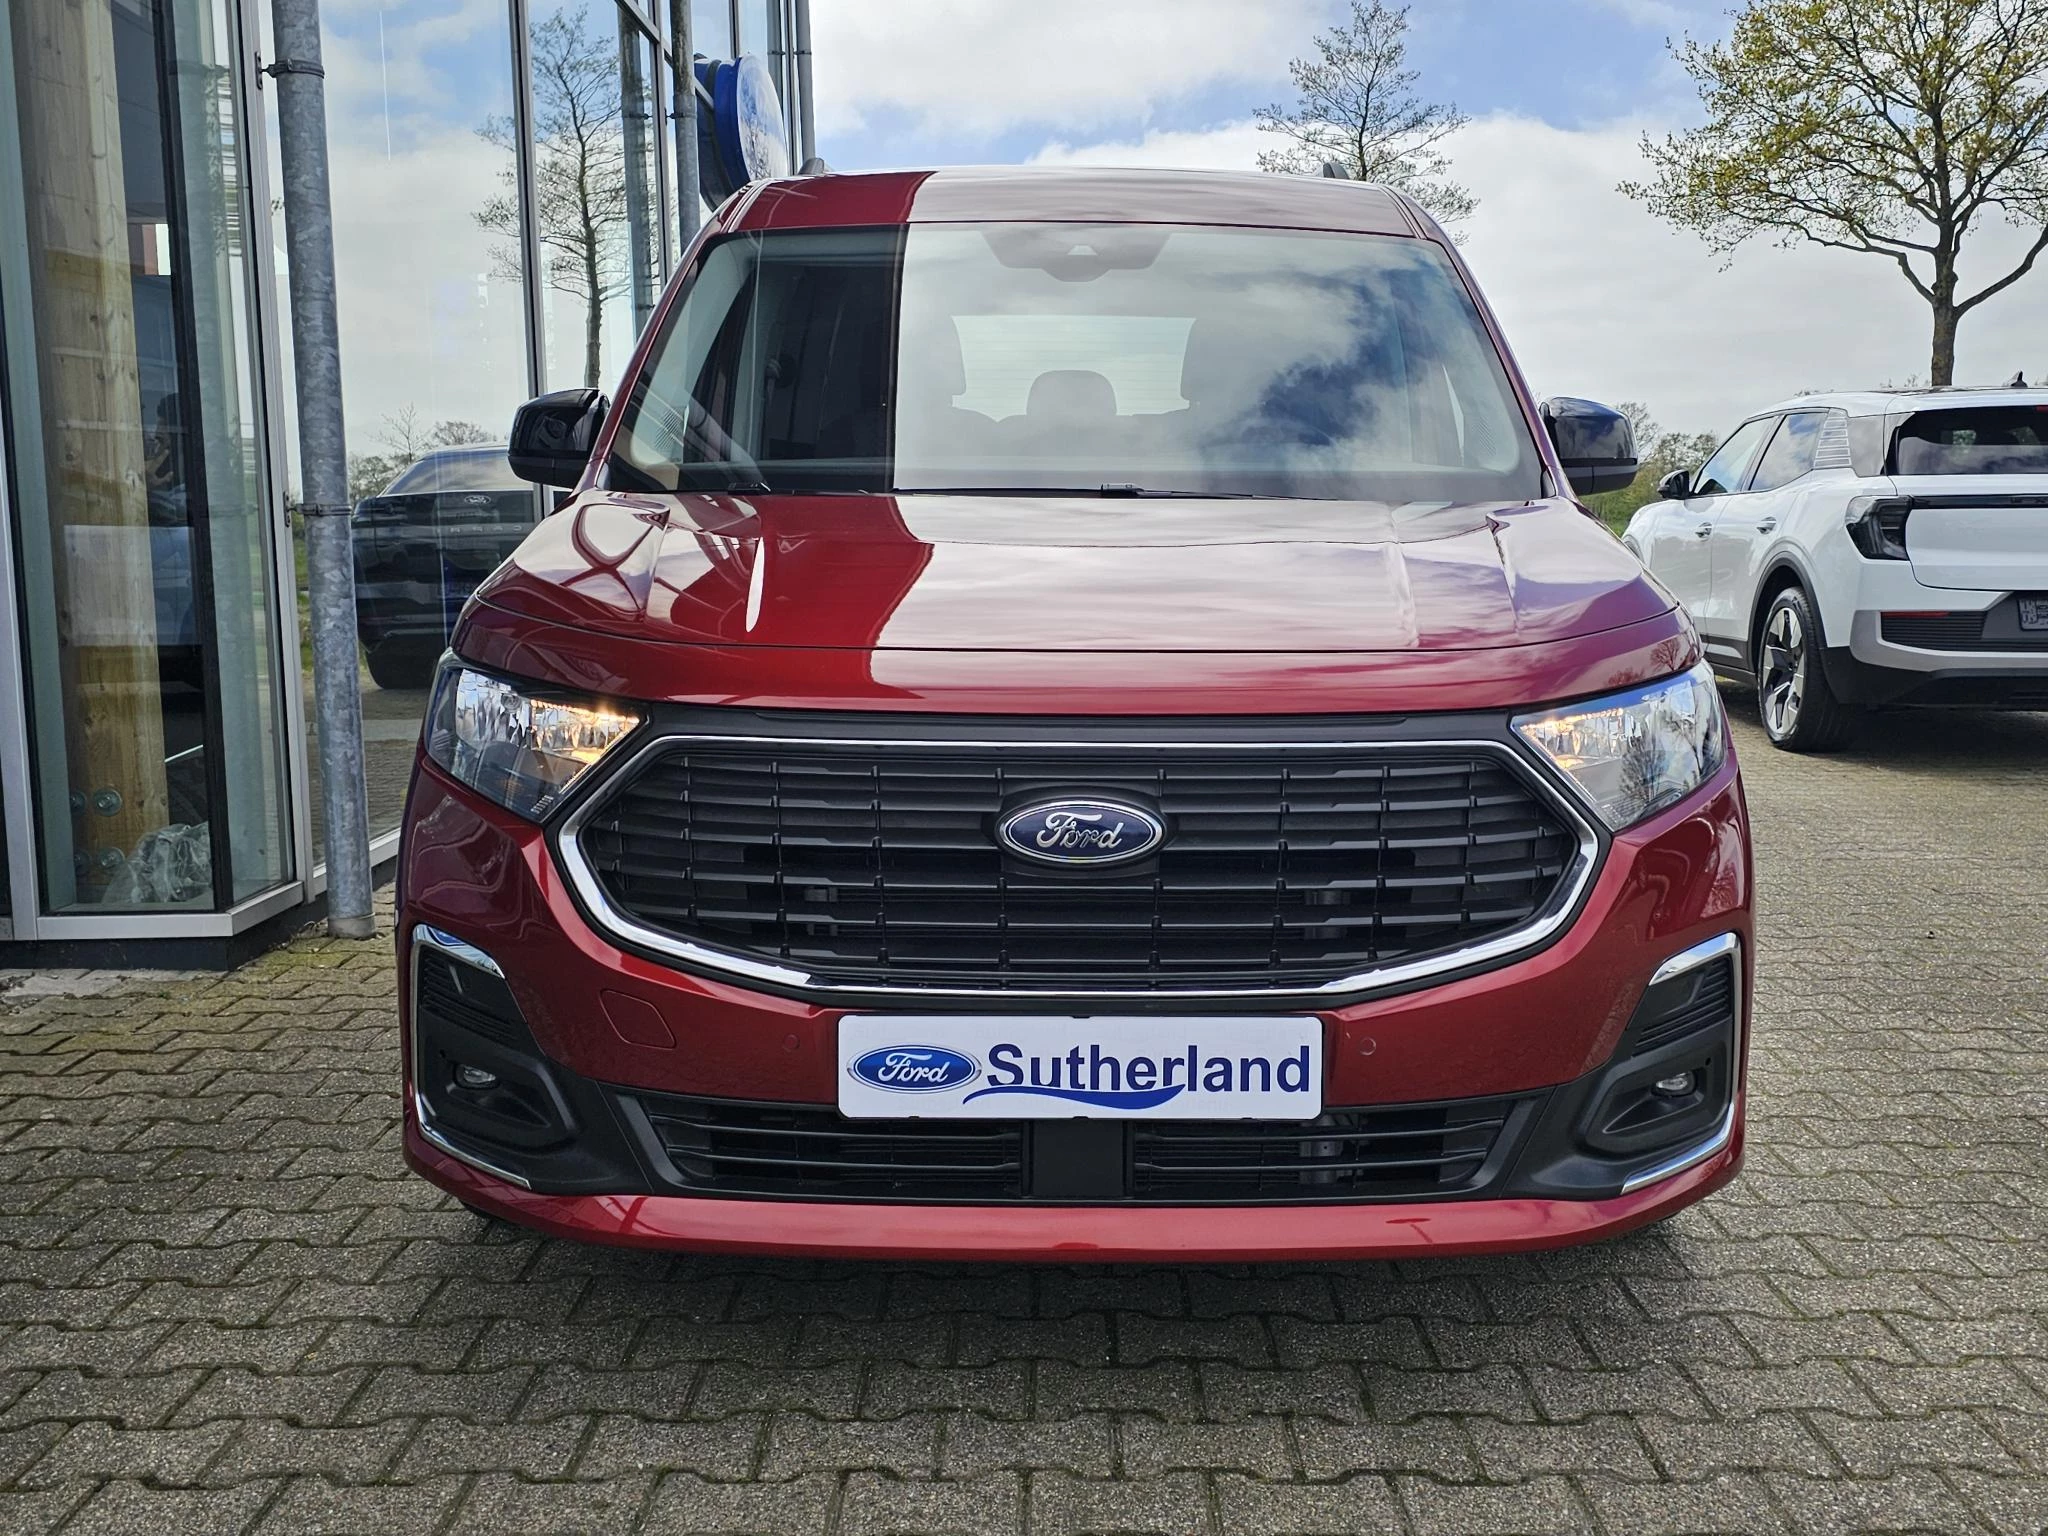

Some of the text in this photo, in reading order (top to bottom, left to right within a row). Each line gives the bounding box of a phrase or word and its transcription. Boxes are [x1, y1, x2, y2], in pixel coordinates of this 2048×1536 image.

[1036, 811, 1124, 848] Ford
[877, 1043, 1310, 1092] Ford Sutherland
